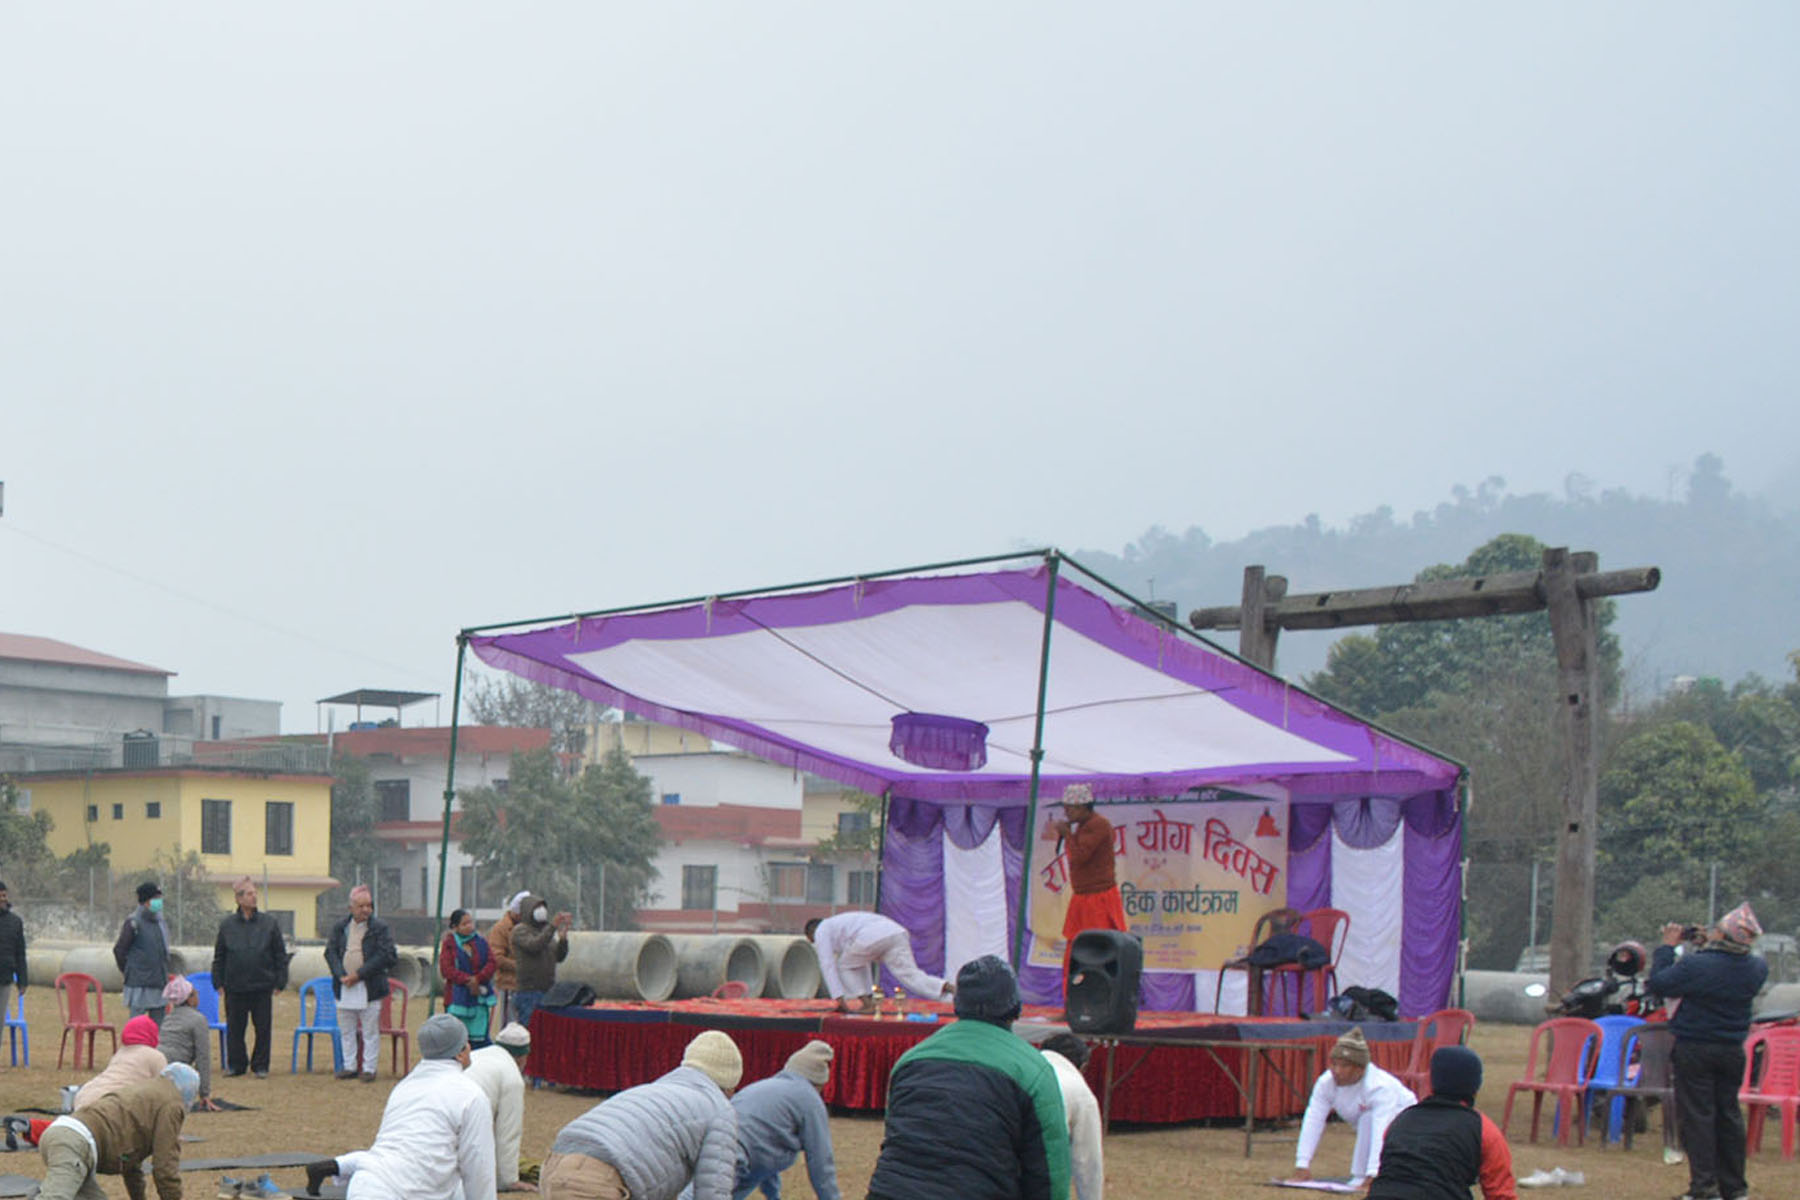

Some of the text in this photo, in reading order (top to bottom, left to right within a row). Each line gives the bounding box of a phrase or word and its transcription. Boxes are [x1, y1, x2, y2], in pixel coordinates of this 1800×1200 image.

[1136, 809, 1195, 855] योग
[1203, 817, 1279, 895] दिवस
[1162, 884, 1239, 915] कार्यक्रम
